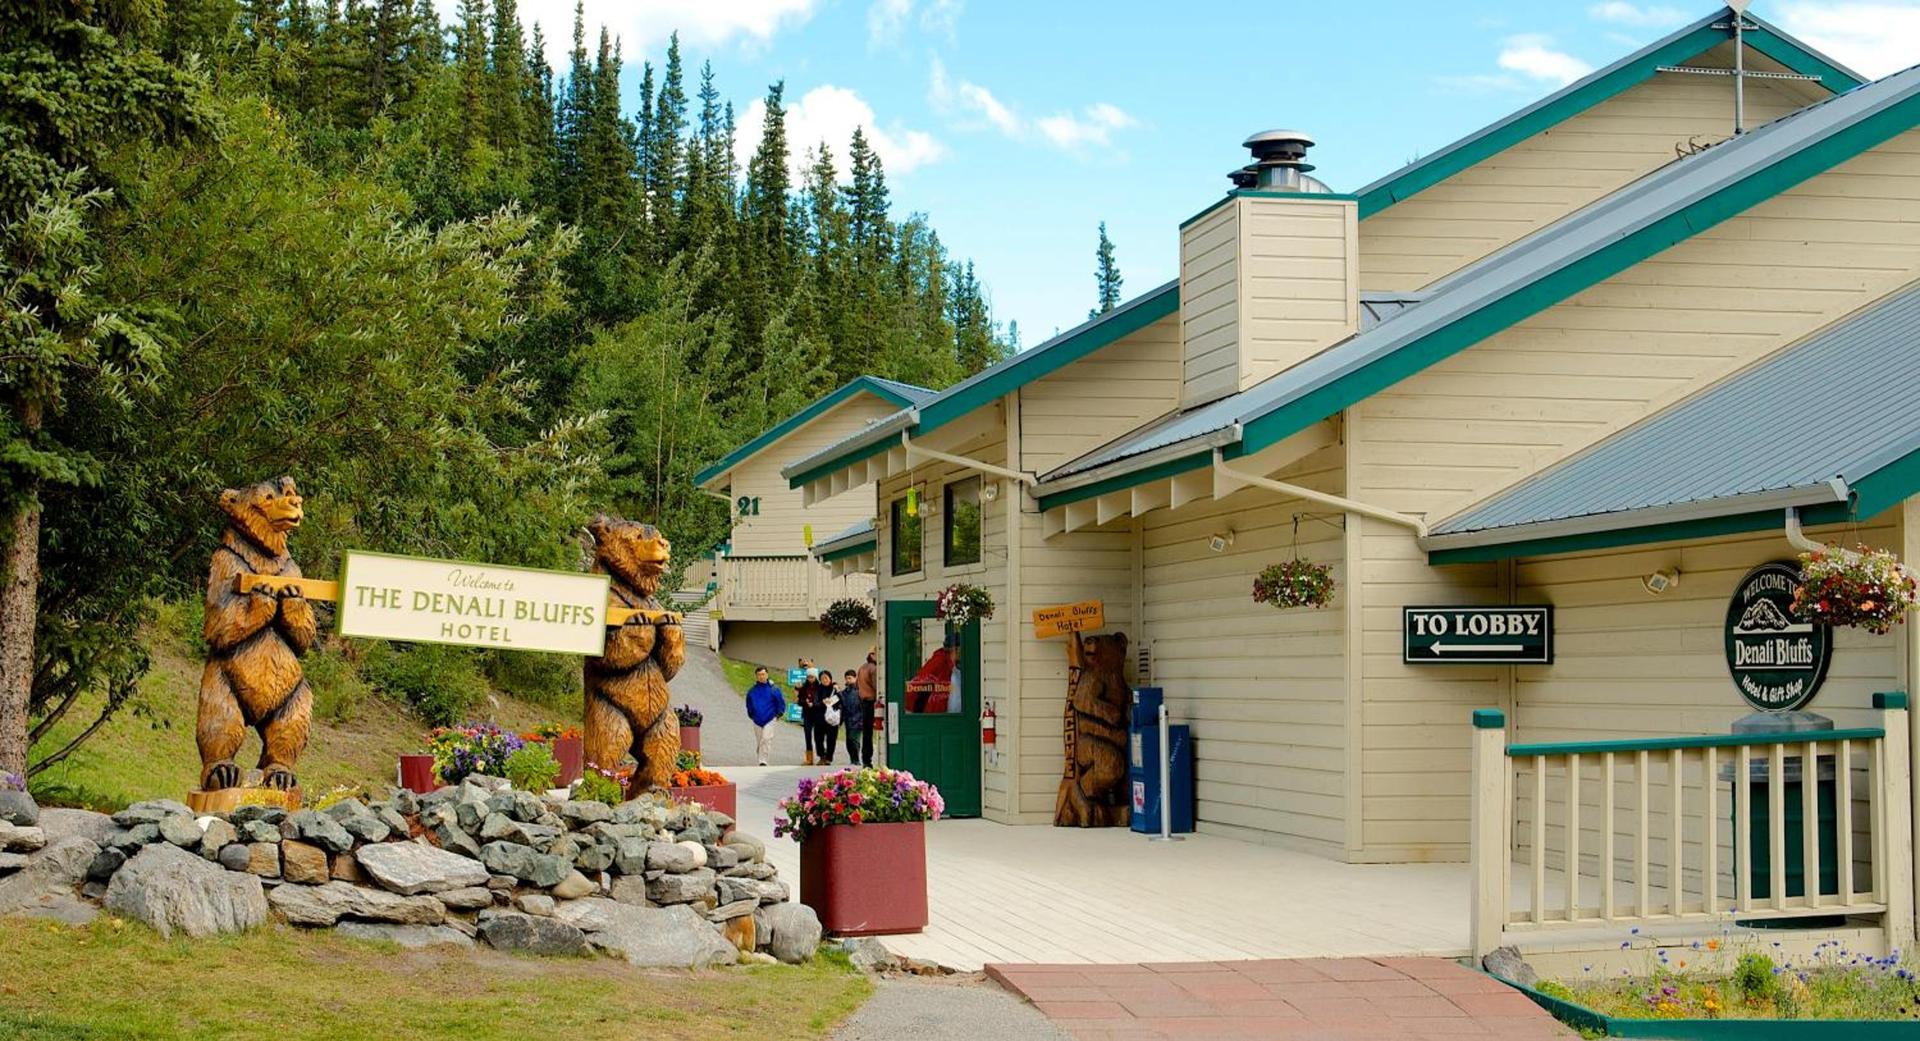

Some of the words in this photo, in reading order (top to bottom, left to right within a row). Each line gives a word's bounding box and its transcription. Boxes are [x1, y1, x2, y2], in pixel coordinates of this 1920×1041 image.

[737, 496, 760, 516] 21
[447, 568, 503, 591] Welcome
[1743, 573, 1787, 604] WELCOME
[355, 585, 402, 610] THE
[412, 590, 504, 619] DENALI
[514, 600, 595, 626] BLUFFS
[1039, 611, 1065, 621] Denali
[1072, 606, 1098, 616] Bluffs
[440, 622, 513, 643] HOTEL
[1056, 618, 1084, 633] Hotel
[1413, 614, 1448, 636] TO
[1455, 614, 1541, 636] LOBBY
[1735, 637, 1774, 666] Denali
[1776, 637, 1813, 665] Bluffs
[906, 684, 933, 693] Denali
[1741, 674, 1762, 699] Hotel
[1761, 686, 1769, 702] &
[1769, 686, 1785, 703] Gift
[1785, 678, 1803, 700] Shop
